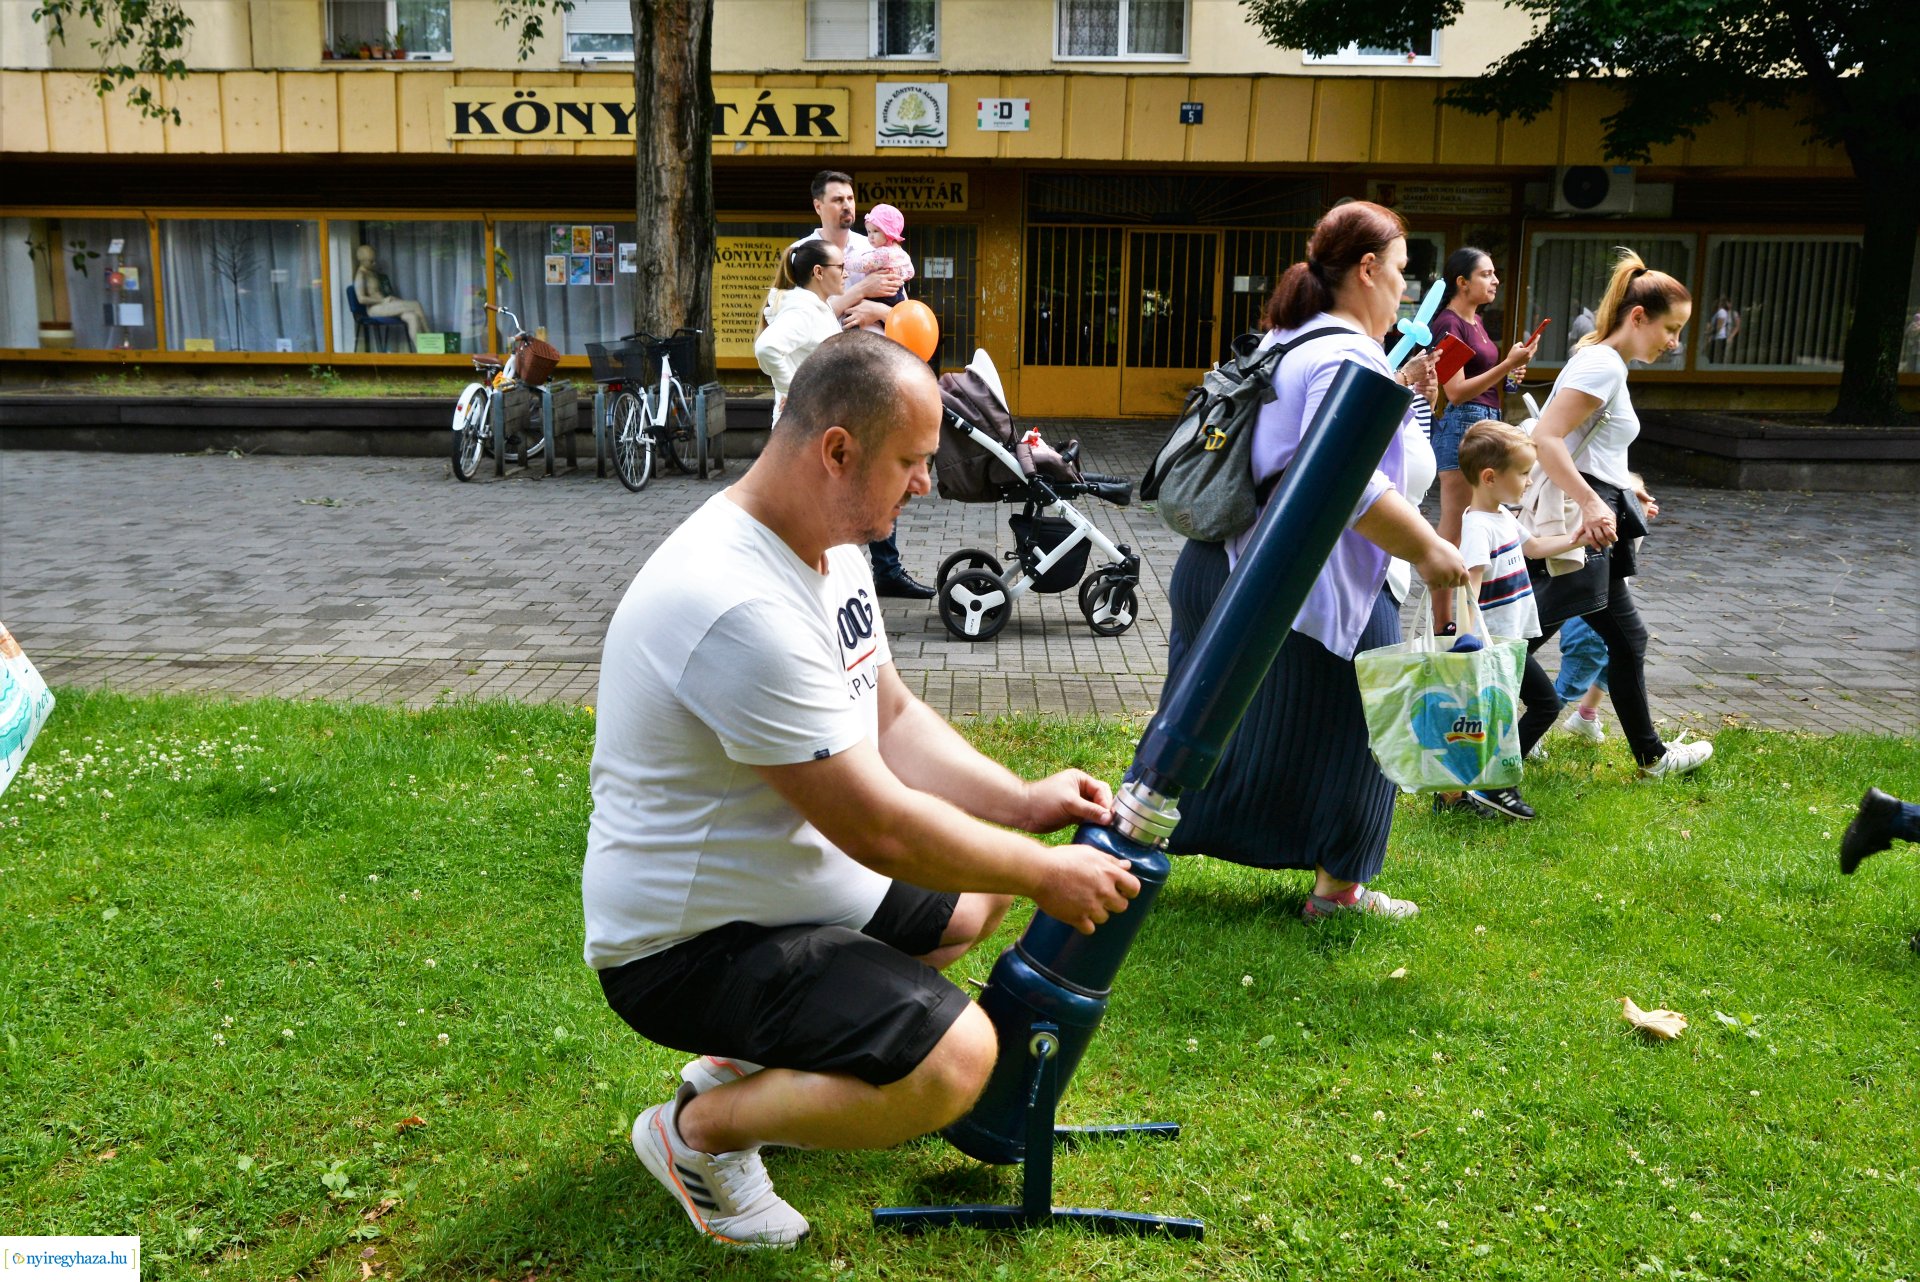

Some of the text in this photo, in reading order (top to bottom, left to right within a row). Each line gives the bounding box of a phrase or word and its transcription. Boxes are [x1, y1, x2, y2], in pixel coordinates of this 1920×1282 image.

[452, 90, 842, 136] KÖNYTÁR
[1188, 110, 1194, 123] 5
[886, 176, 935, 184] NYÍRSÉG
[857, 182, 963, 203] KÖNYVTÁR
[713, 247, 781, 263] KÖNYVTÁ
[1453, 717, 1482, 733] dm
